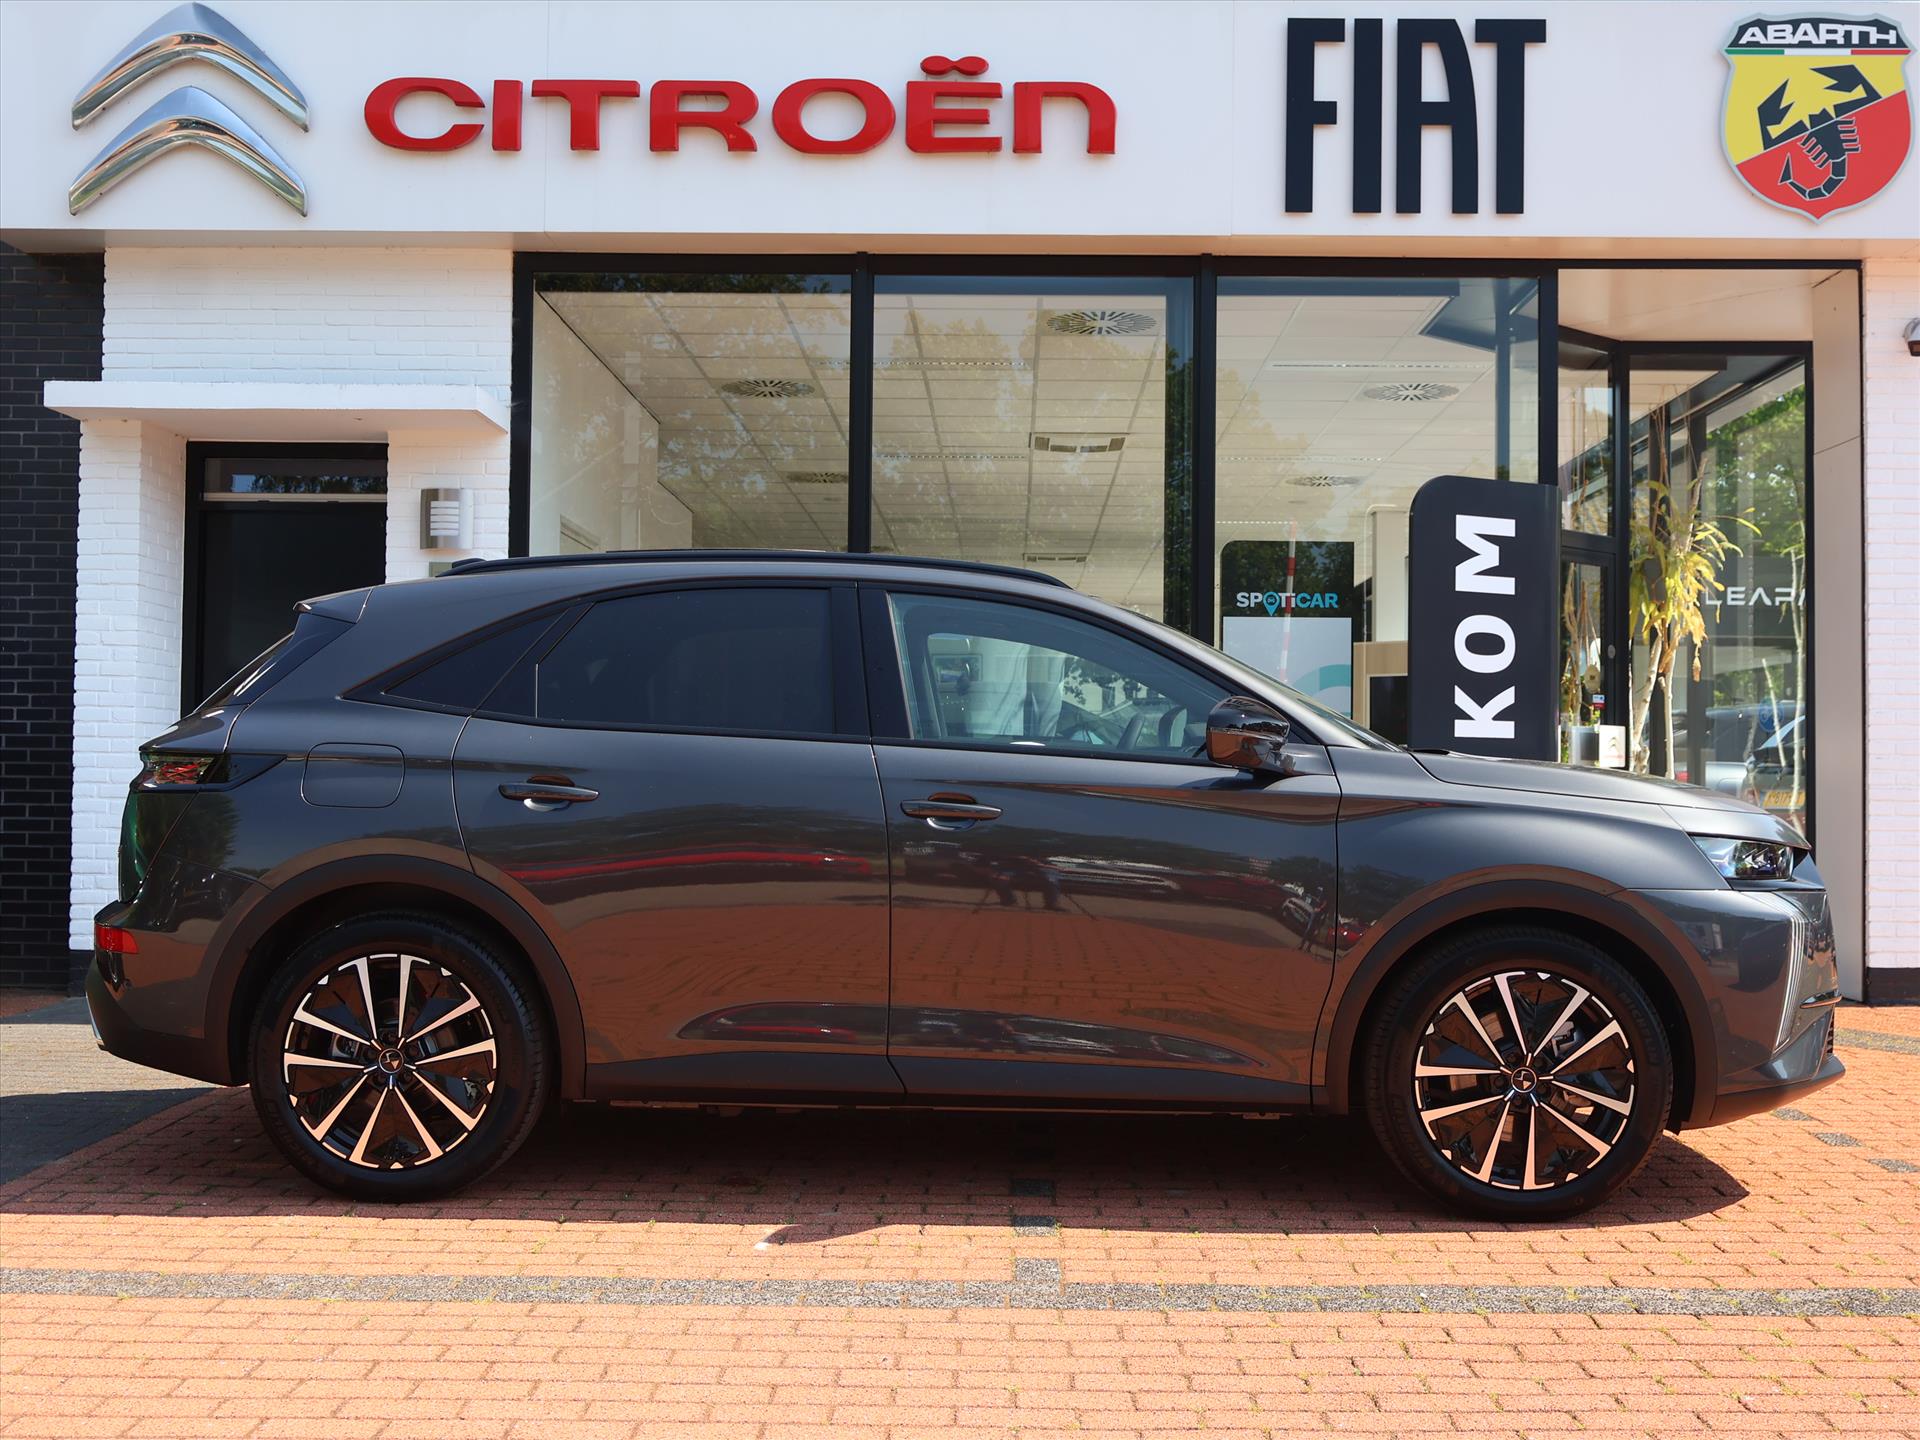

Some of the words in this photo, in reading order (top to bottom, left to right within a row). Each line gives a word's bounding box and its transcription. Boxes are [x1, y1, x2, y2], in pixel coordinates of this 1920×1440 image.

[1284, 17, 1547, 214] FIAT
[1737, 22, 1897, 45] ABARTH
[1454, 514, 1516, 739] KOM
